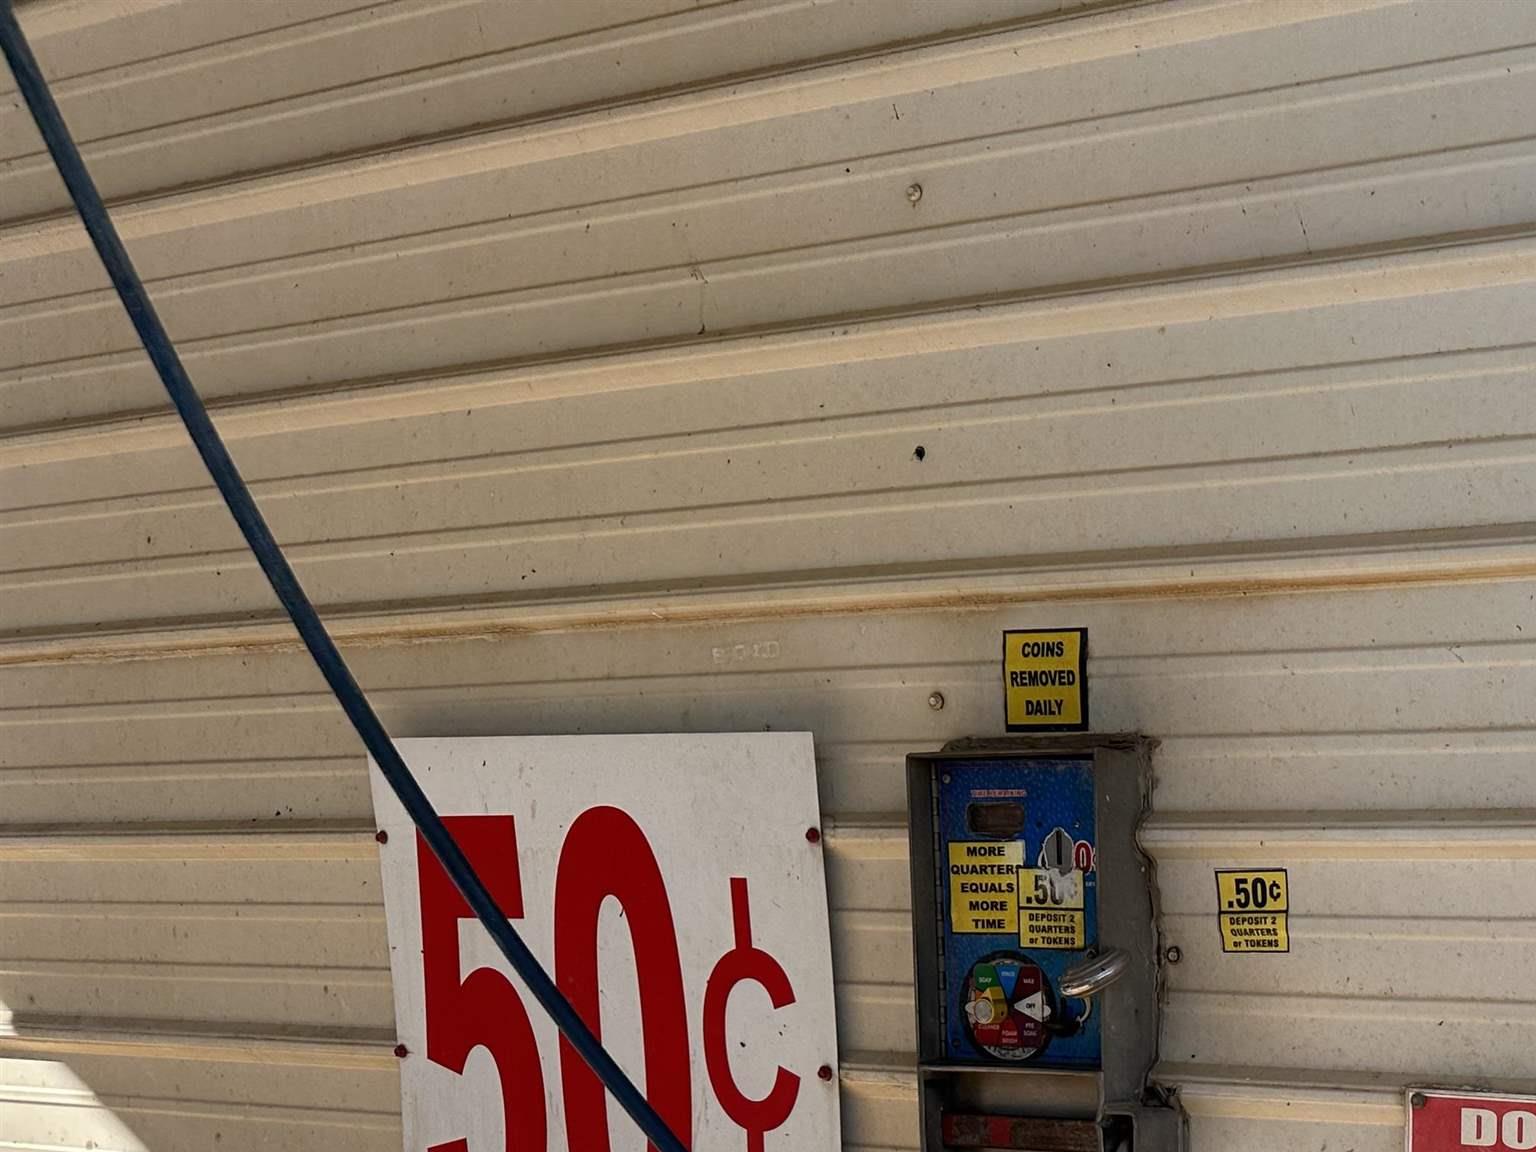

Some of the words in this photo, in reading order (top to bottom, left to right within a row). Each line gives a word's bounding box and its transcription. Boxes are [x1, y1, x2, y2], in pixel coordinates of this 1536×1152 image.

[1022, 641, 1064, 658] COINS
[1010, 670, 1075, 687] REMOVED
[1025, 699, 1064, 716] DAILY
[966, 846, 1006, 857] MORE
[960, 882, 1015, 893] EQUALS
[969, 901, 1008, 911] MORE
[1029, 913, 1066, 922] DEPOSIT
[1229, 917, 1268, 925] DEPOSIT
[972, 919, 1006, 929] TIME
[1029, 925, 1076, 934] QUARTERS
[1230, 928, 1278, 937] QUARTERS
[1041, 936, 1076, 946] TOKENS
[1244, 939, 1279, 948] TOKENS
